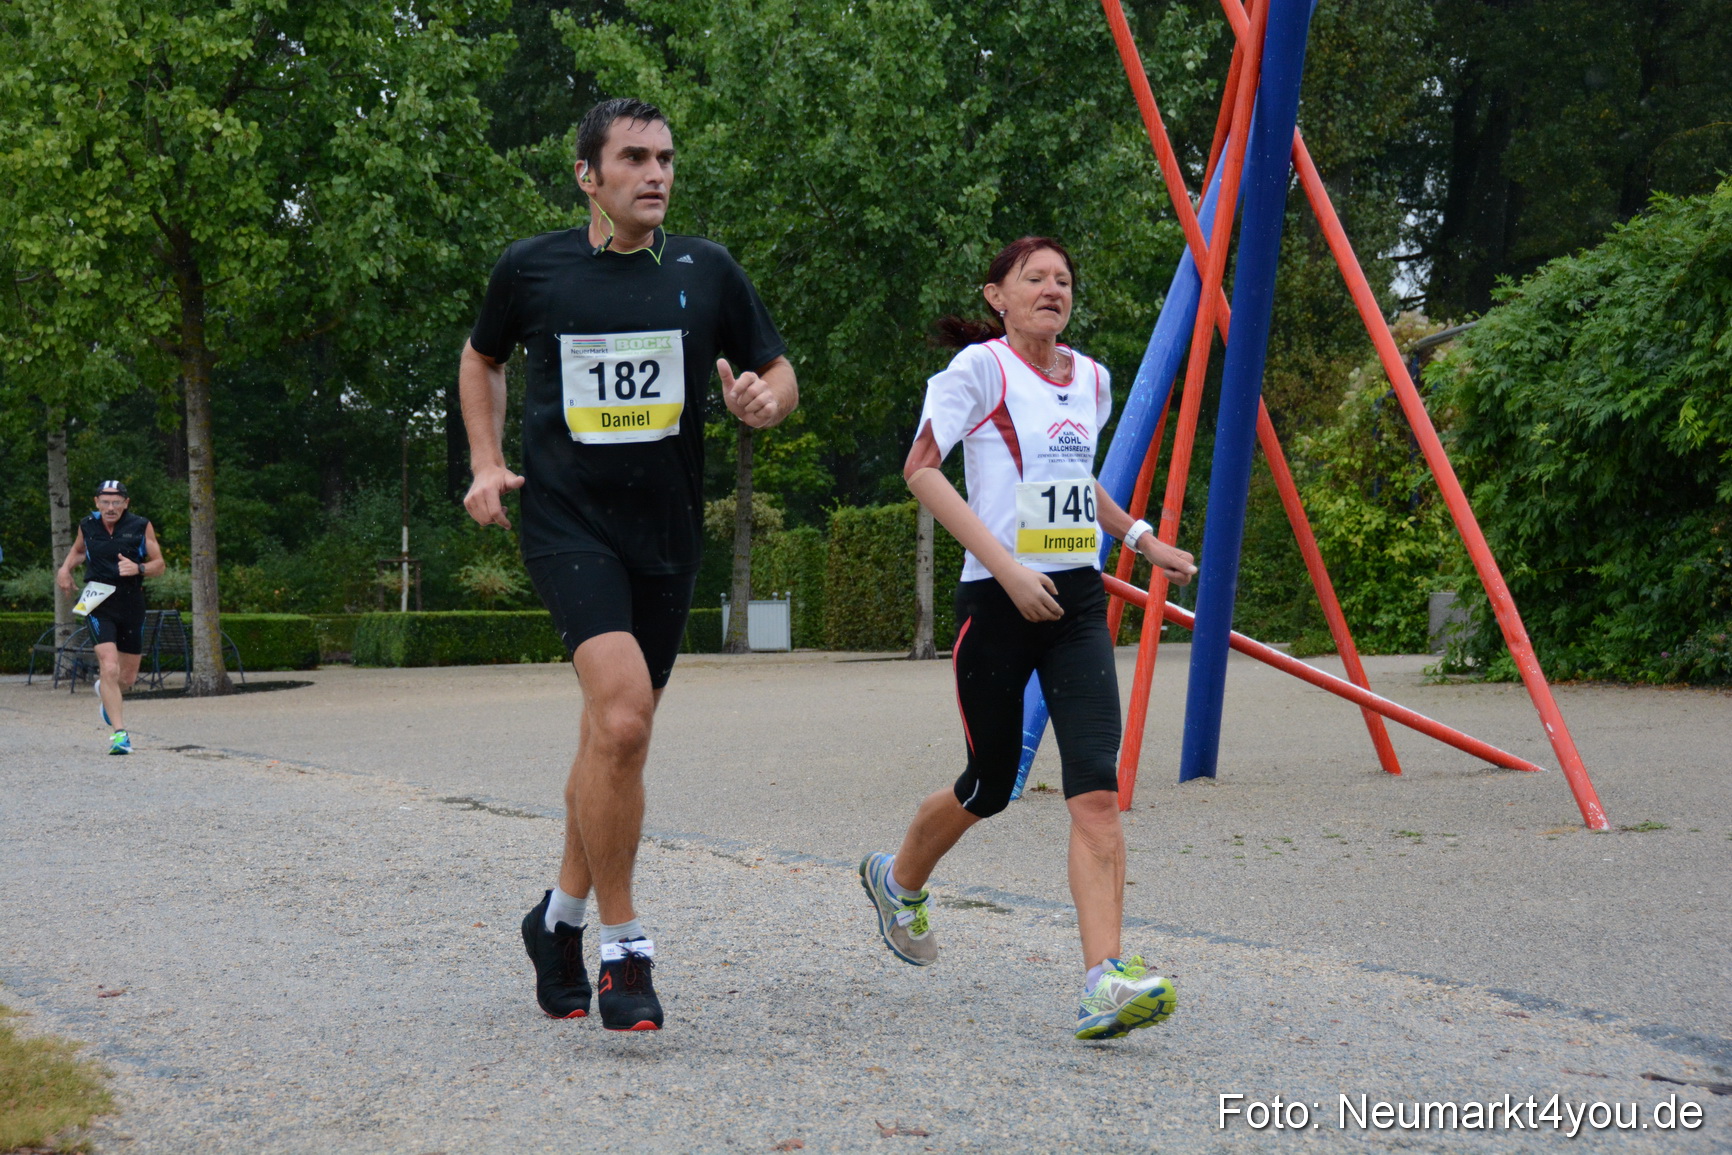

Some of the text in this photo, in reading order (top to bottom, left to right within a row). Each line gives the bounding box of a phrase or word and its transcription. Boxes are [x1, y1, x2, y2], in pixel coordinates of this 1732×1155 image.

[615, 336, 672, 351] BOCK
[589, 360, 660, 400] 182
[601, 411, 650, 427] Daniel
[1041, 485, 1095, 523] 146
[1044, 534, 1095, 552] Irmgard
